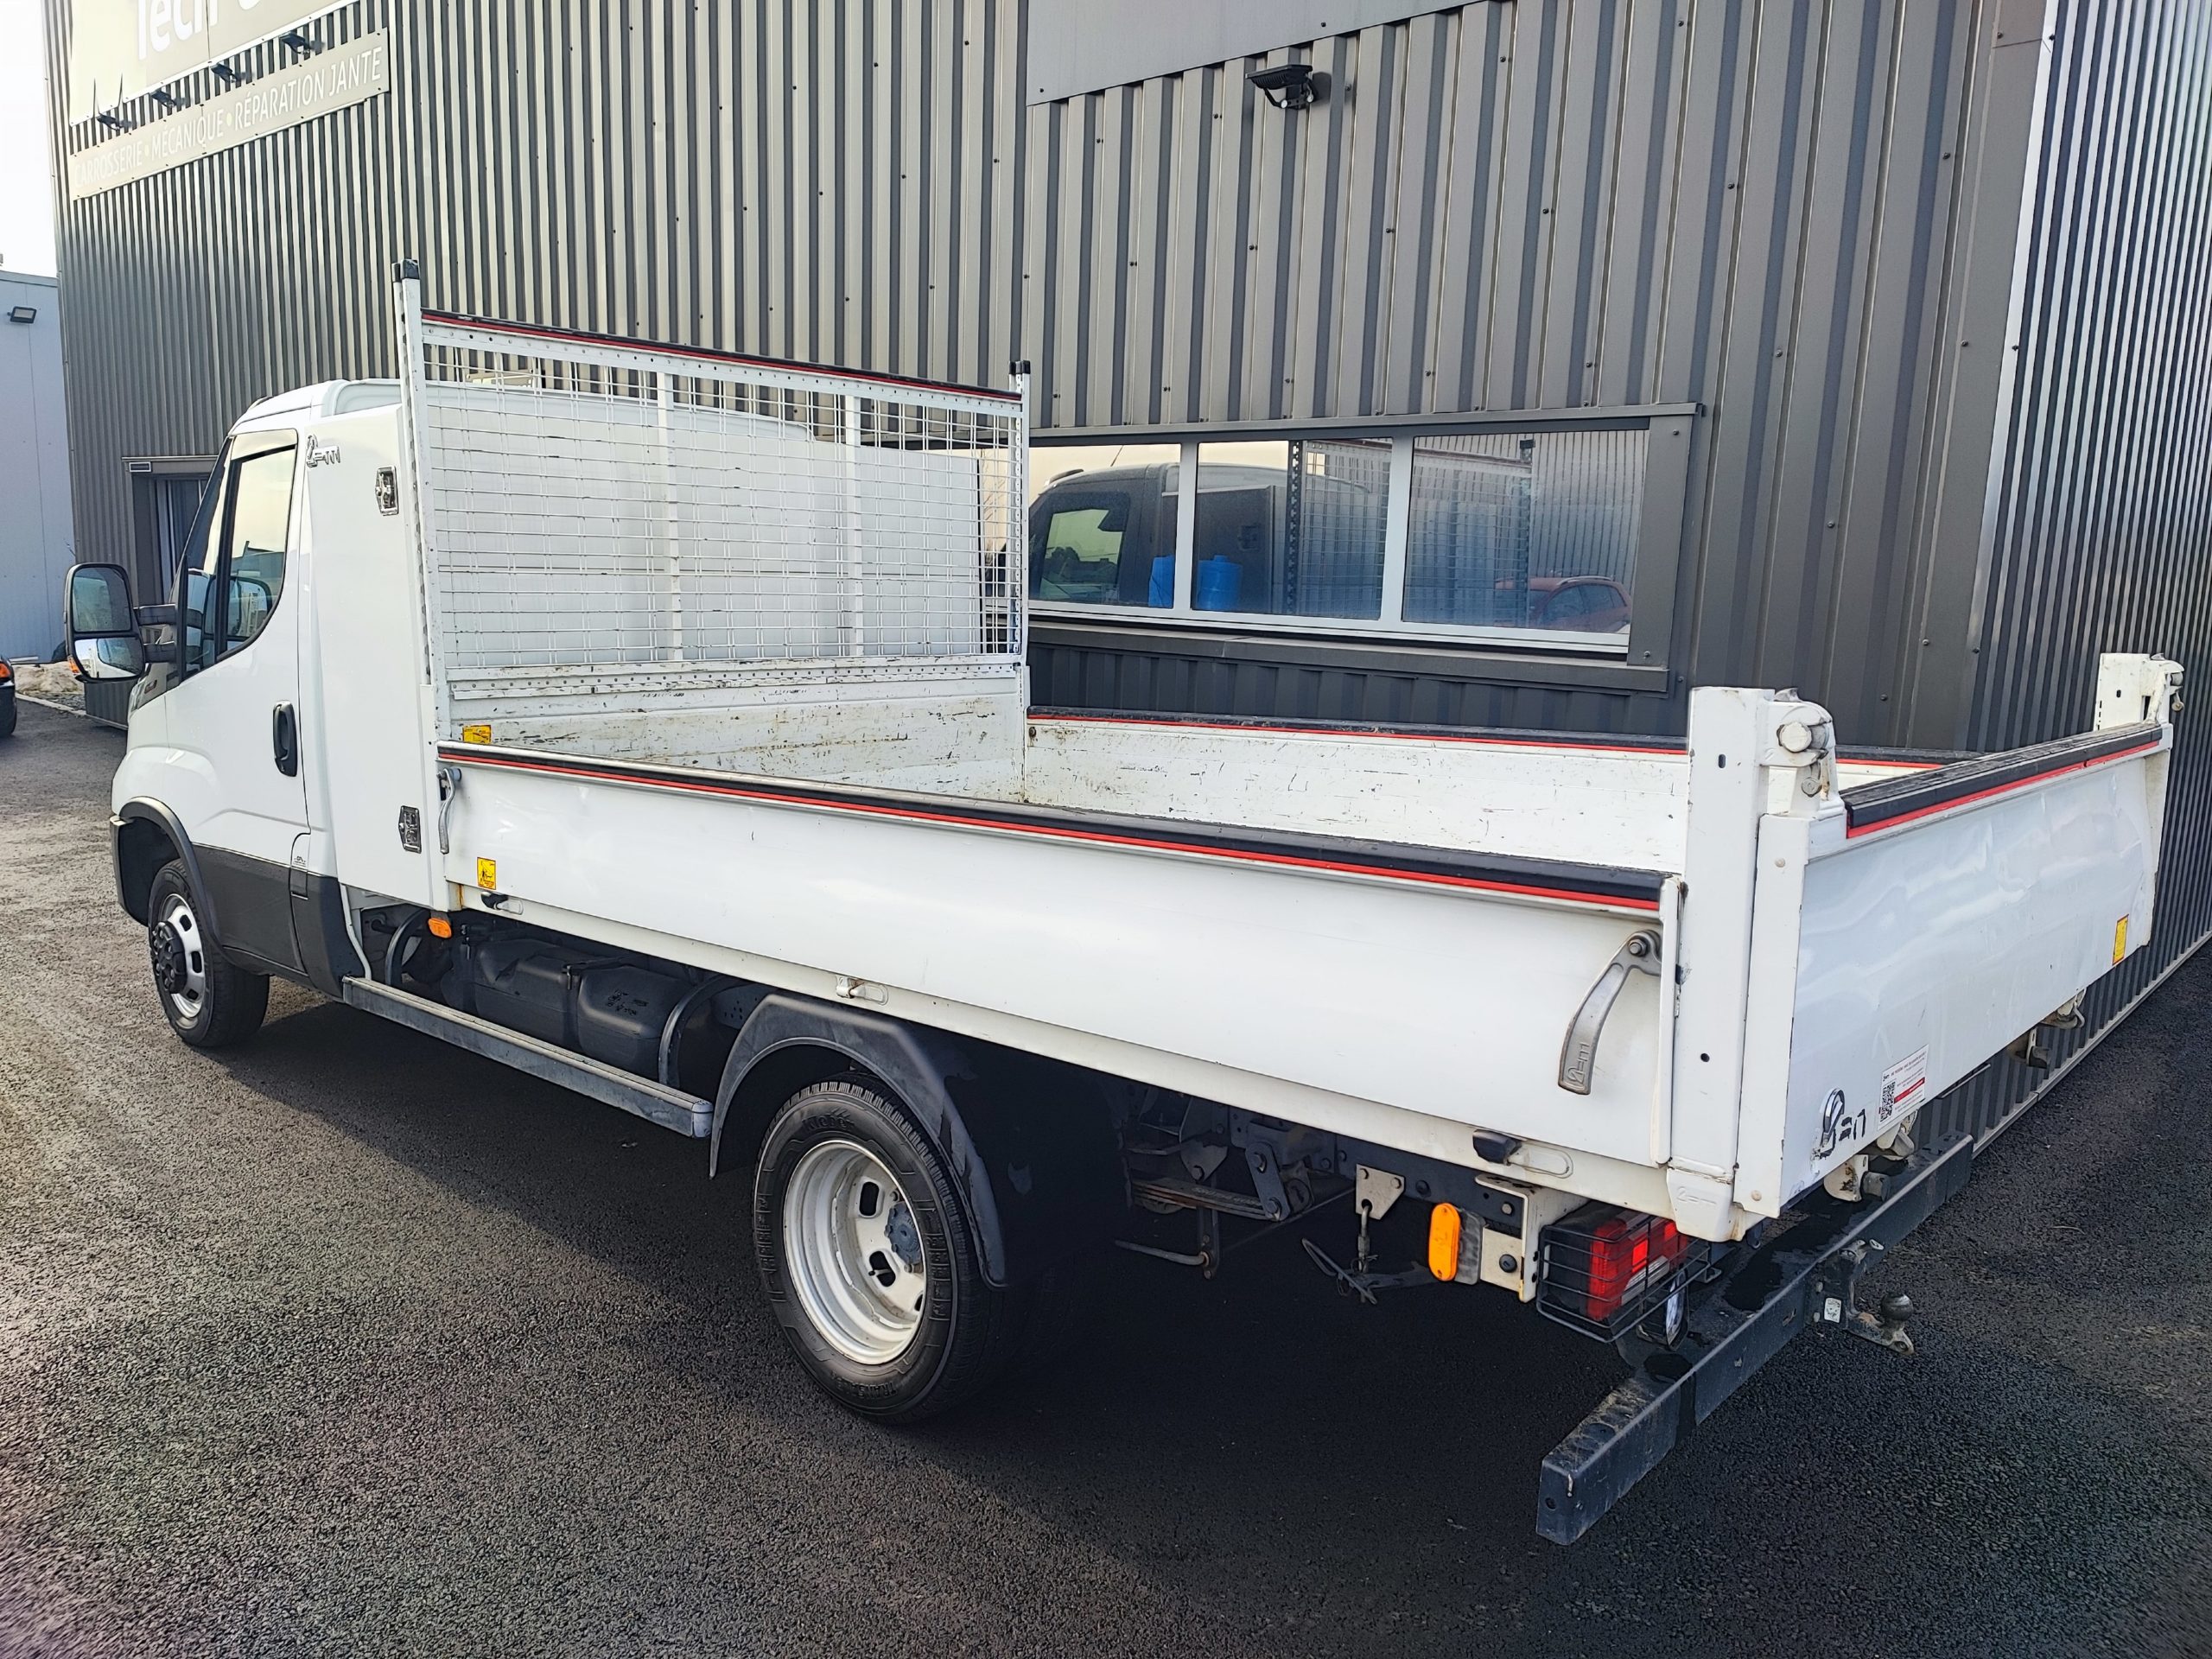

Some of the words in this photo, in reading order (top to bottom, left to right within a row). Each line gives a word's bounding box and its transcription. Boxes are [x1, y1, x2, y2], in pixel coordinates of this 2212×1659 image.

[75, 141, 143, 188] CARROSSERIE
[151, 109, 225, 162] MÉCANIQUE
[234, 68, 325, 130] RÉPARATION
[328, 47, 383, 97] JANTE
